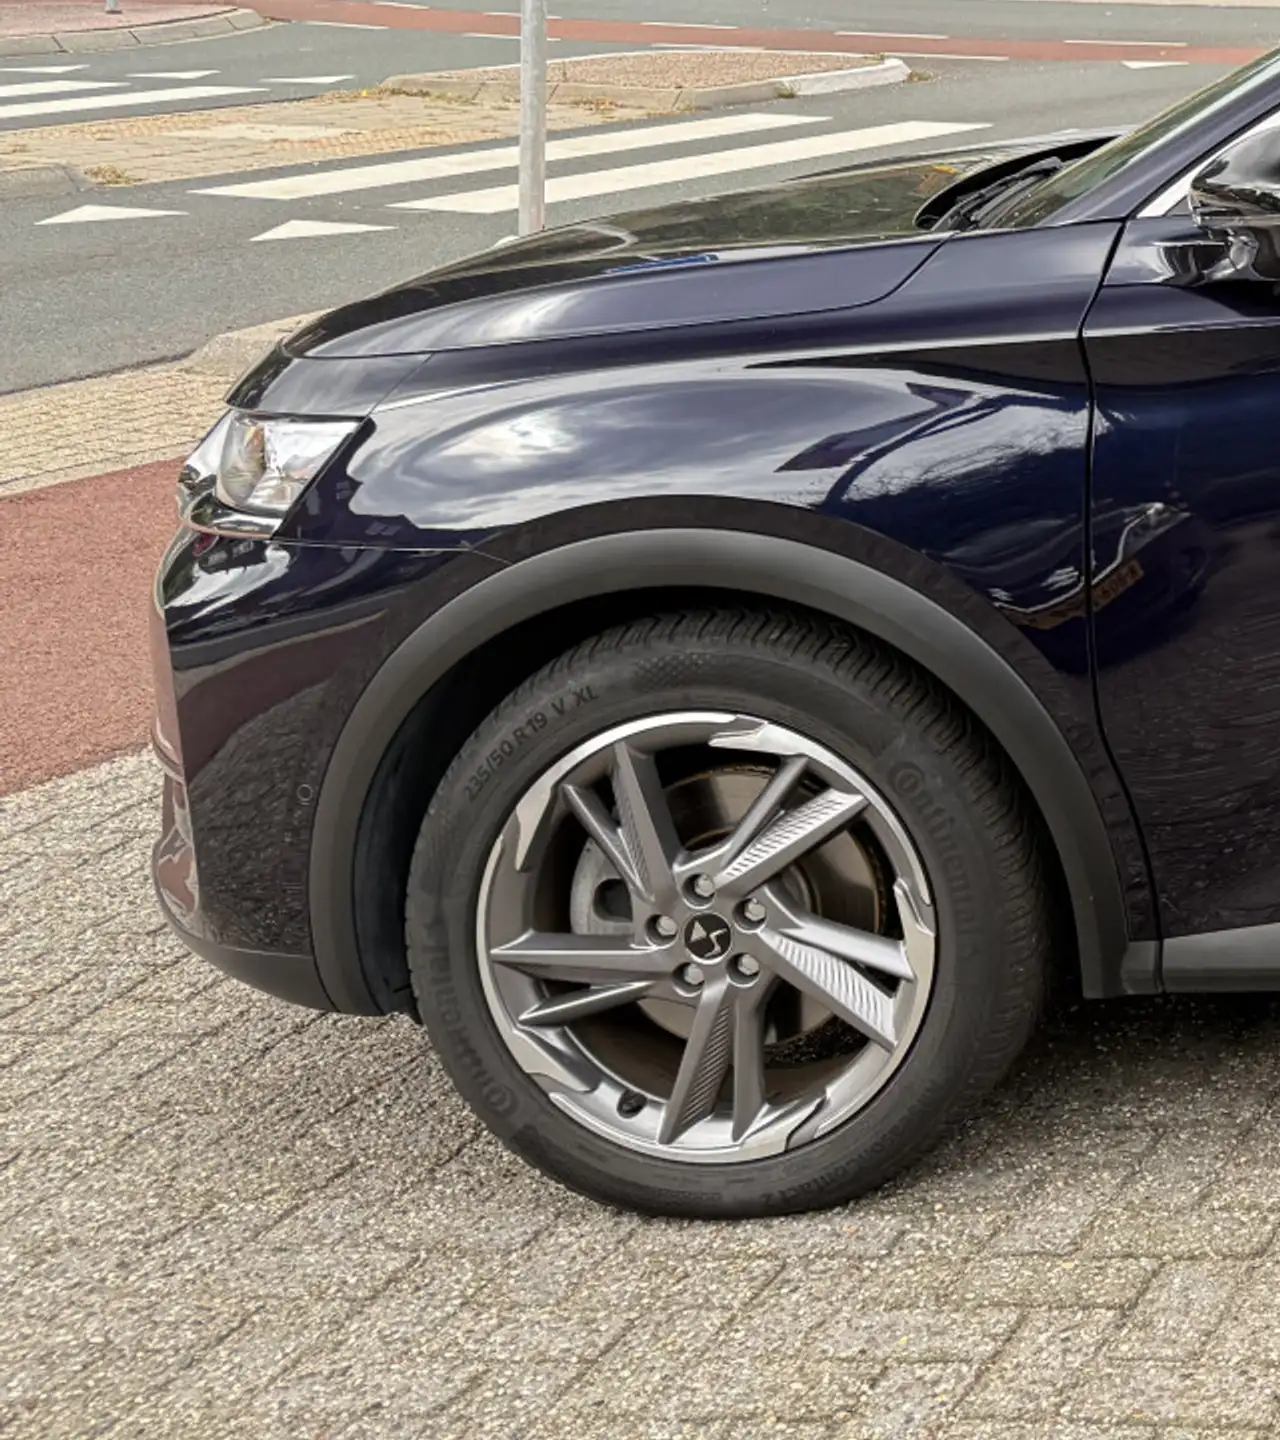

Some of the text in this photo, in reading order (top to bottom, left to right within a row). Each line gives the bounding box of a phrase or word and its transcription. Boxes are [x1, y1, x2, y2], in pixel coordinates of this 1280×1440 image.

[464, 739, 515, 803] 235/50
[551, 697, 566, 717] V
[573, 684, 600, 707] XL
